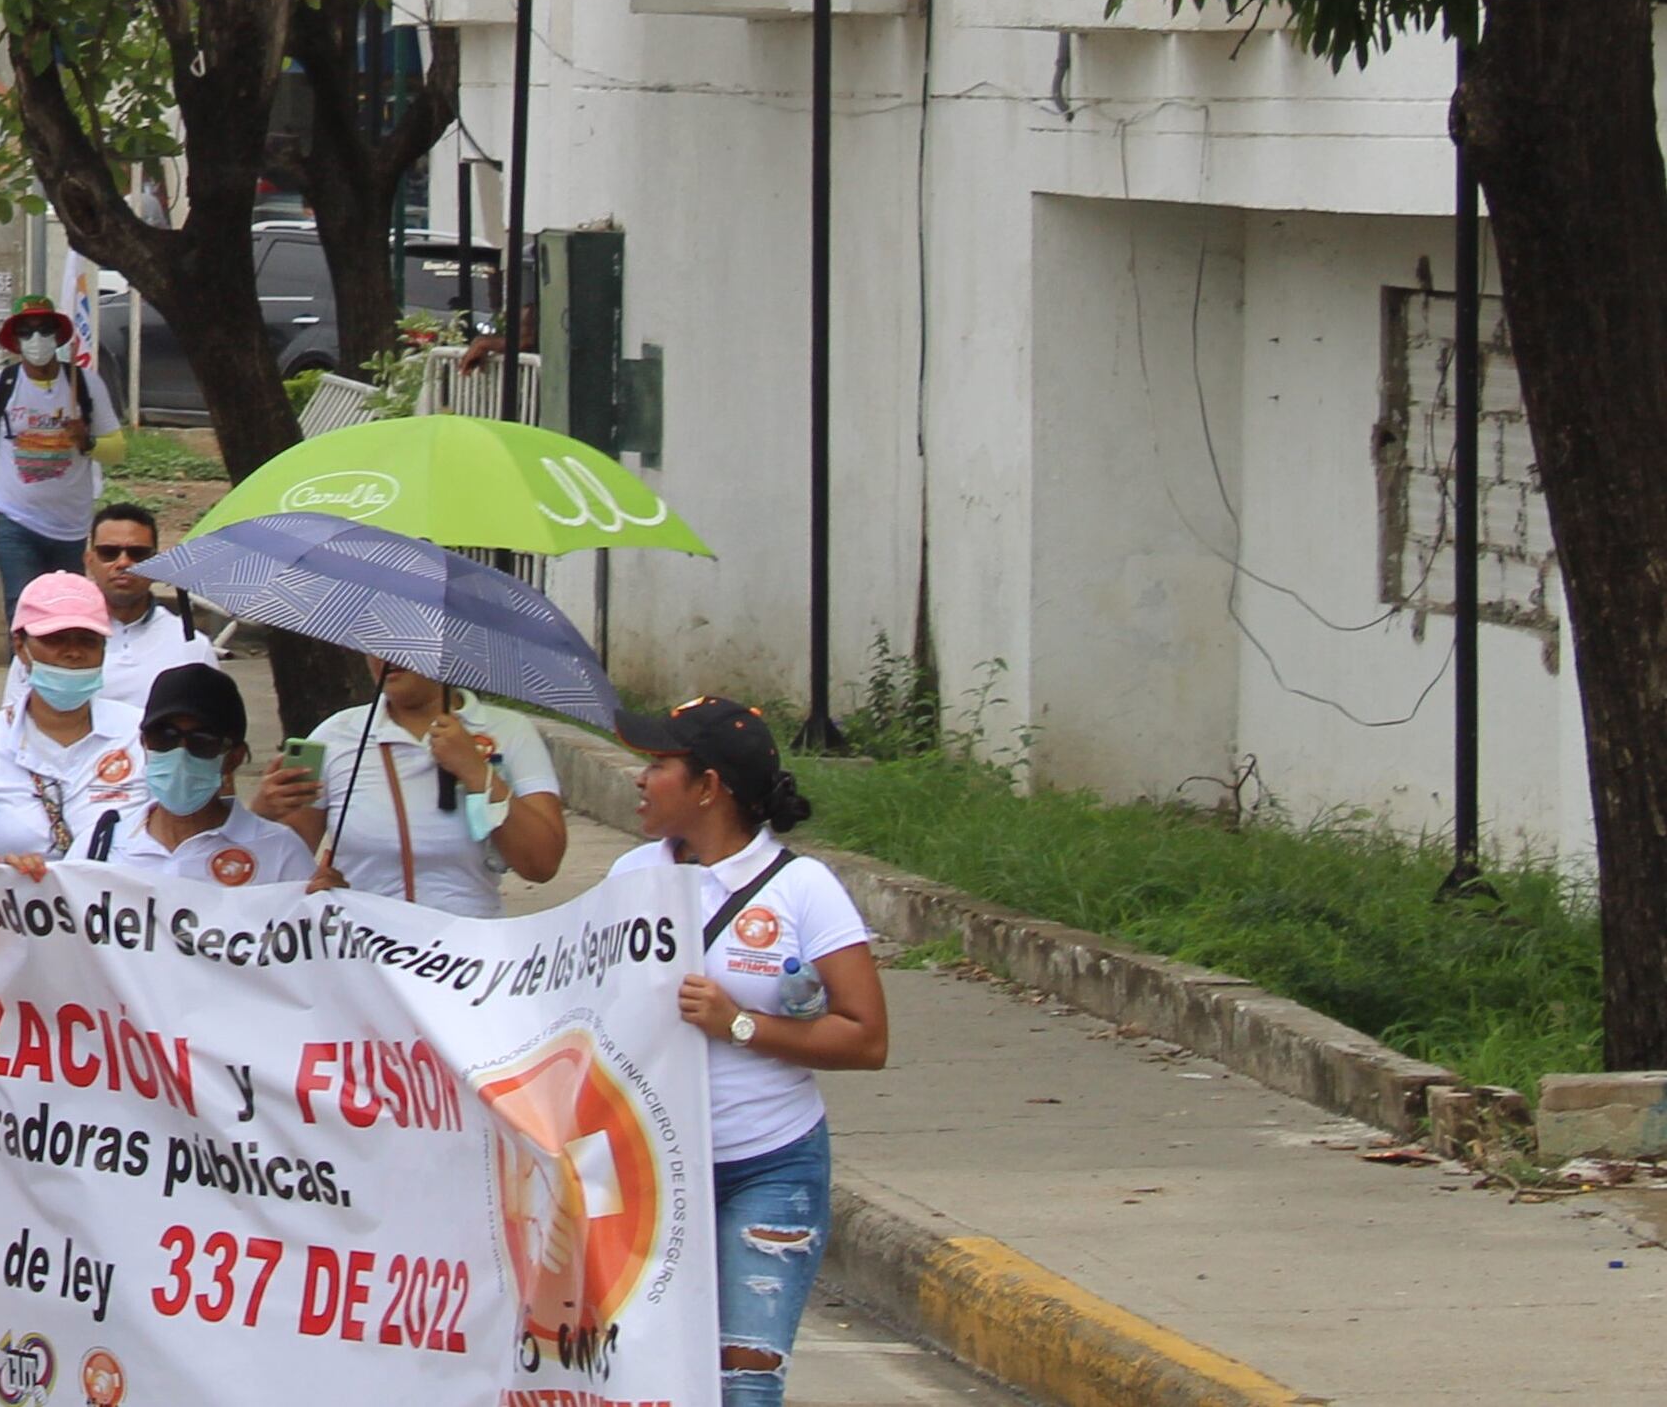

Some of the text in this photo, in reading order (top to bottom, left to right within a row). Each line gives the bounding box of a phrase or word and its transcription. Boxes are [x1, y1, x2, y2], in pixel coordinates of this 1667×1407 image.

[291, 481, 387, 509] Carulla
[85, 891, 155, 952] del
[171, 908, 312, 966] Sector
[319, 904, 484, 990] Financiero
[470, 961, 514, 1006] y
[509, 943, 546, 995] de
[545, 935, 576, 992] los
[578, 917, 676, 988] Seguros
[226, 1065, 255, 1123] y
[163, 1135, 352, 1208] públicas.
[3, 1228, 50, 1292] de
[61, 1238, 115, 1323] ley
[152, 1225, 283, 1327] 337
[298, 1245, 376, 1342] DE
[379, 1254, 468, 1354] 2022
